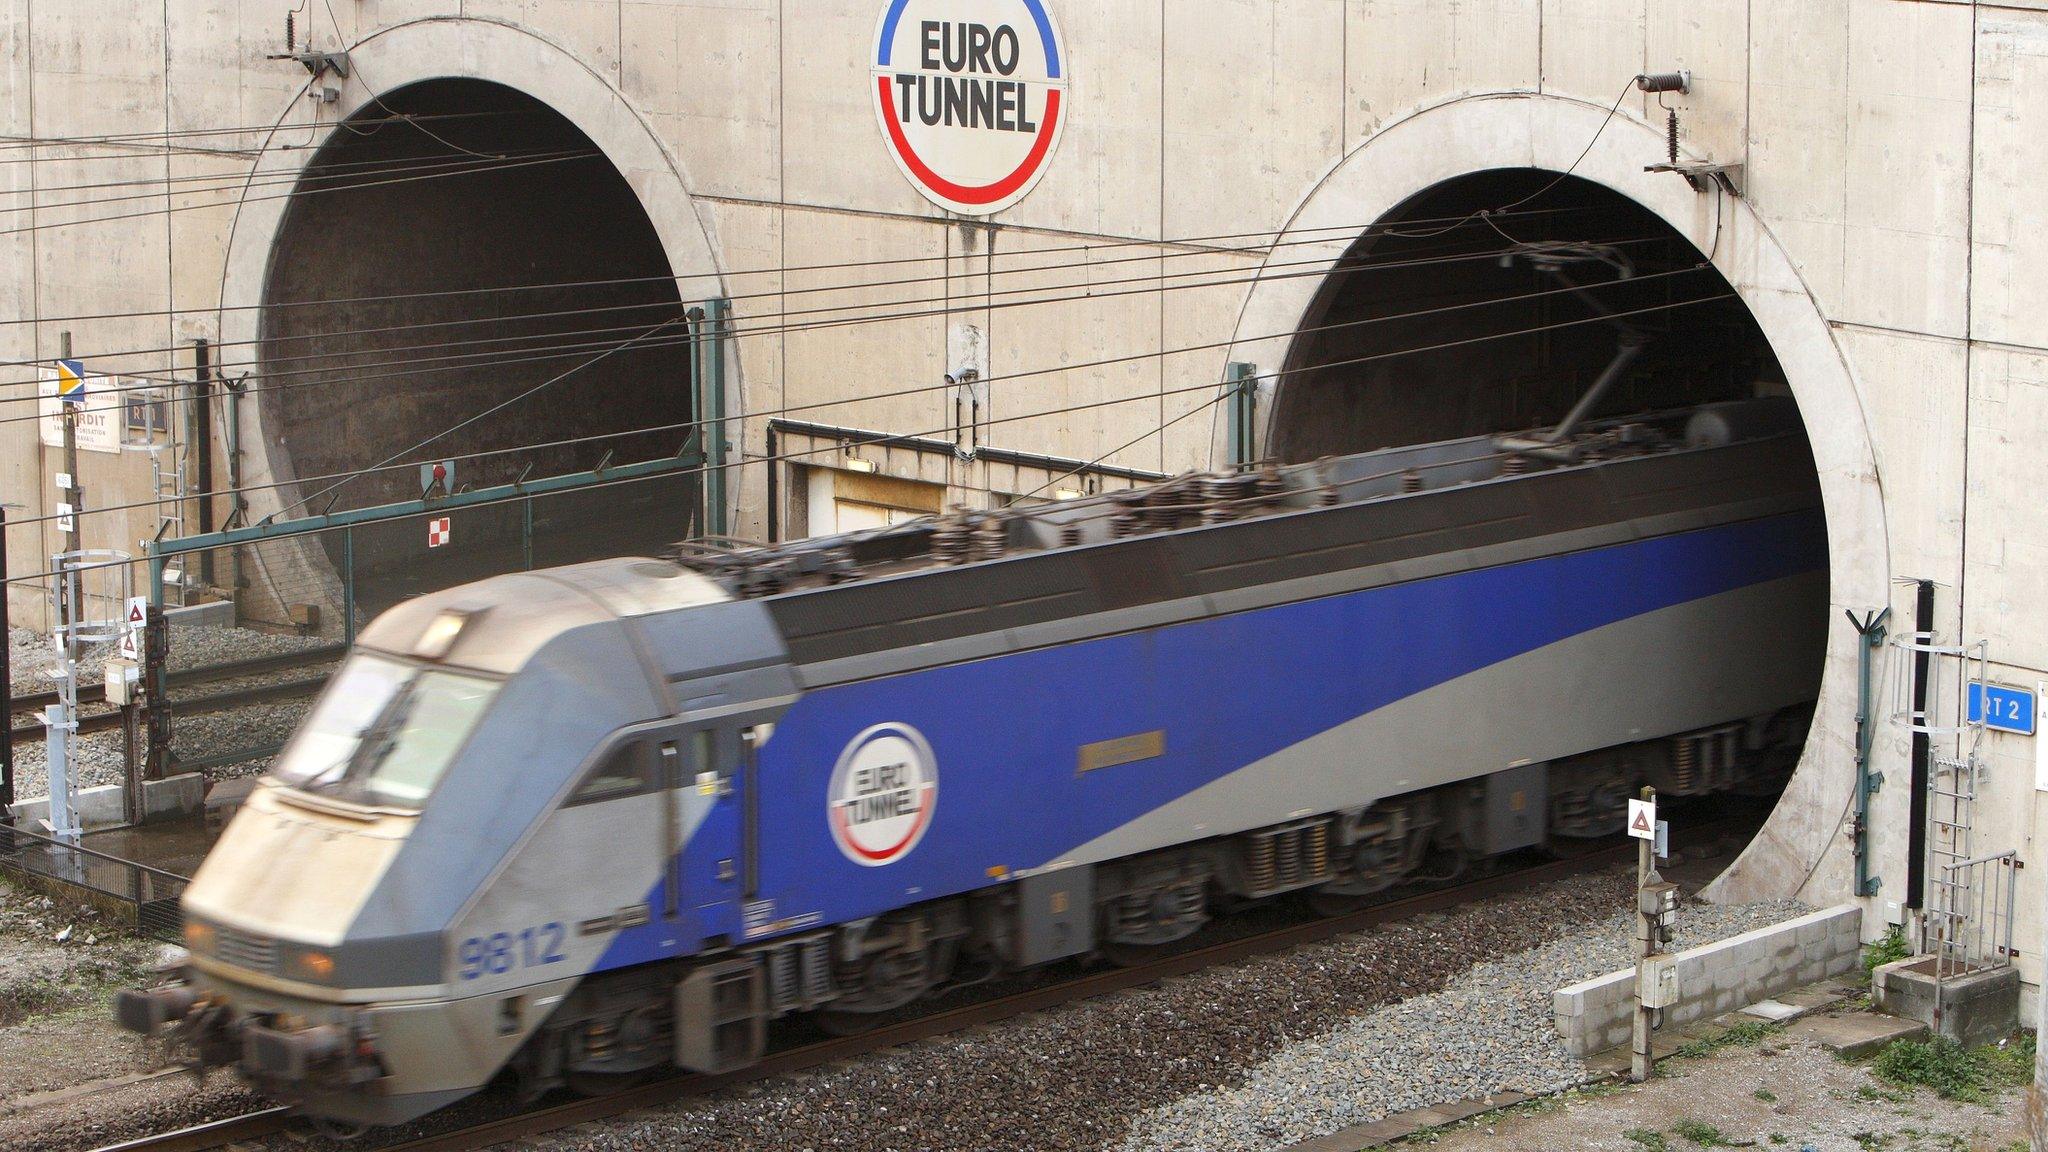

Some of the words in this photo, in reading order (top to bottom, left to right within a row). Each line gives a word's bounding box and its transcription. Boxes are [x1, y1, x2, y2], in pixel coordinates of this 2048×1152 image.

[921, 20, 1019, 76] EURO
[895, 74, 1036, 133] TUNNEL
[2008, 700, 2019, 720] 2
[458, 921, 567, 979] 9812
